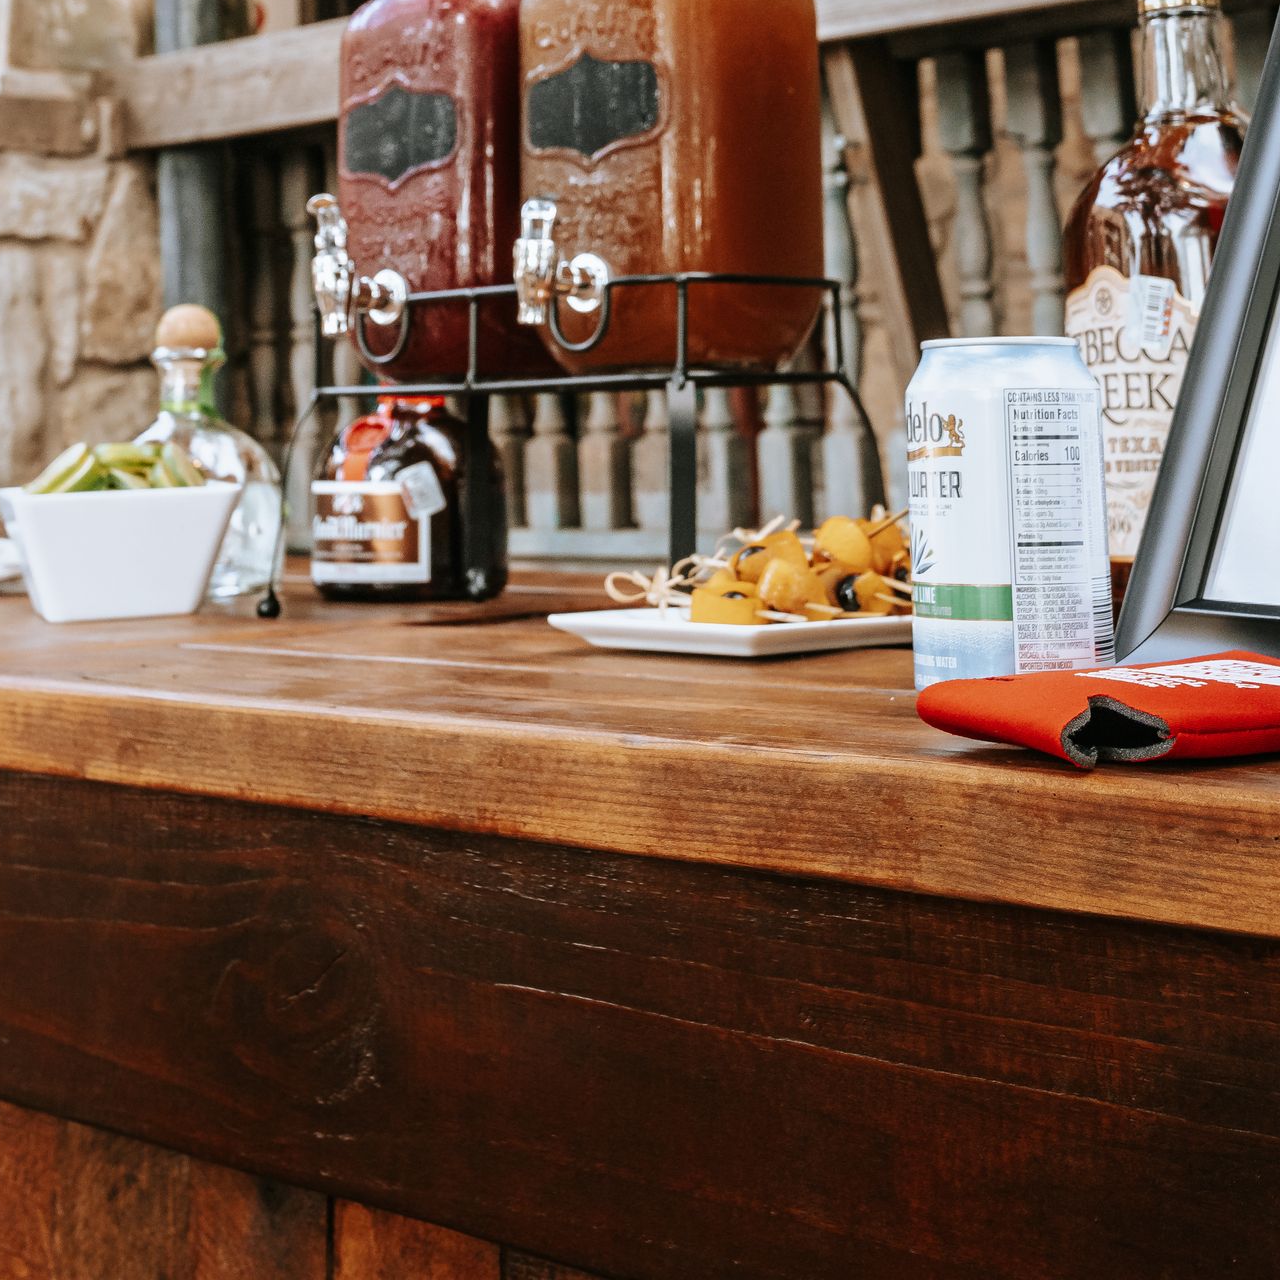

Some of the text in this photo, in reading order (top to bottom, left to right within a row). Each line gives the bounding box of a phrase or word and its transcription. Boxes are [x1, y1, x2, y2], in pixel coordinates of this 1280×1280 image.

[1013, 408, 1078, 420] Nutrition Facts
[1108, 436, 1163, 453] TEXA
[1015, 446, 1080, 461] Calories 100
[910, 471, 962, 498] WAER
